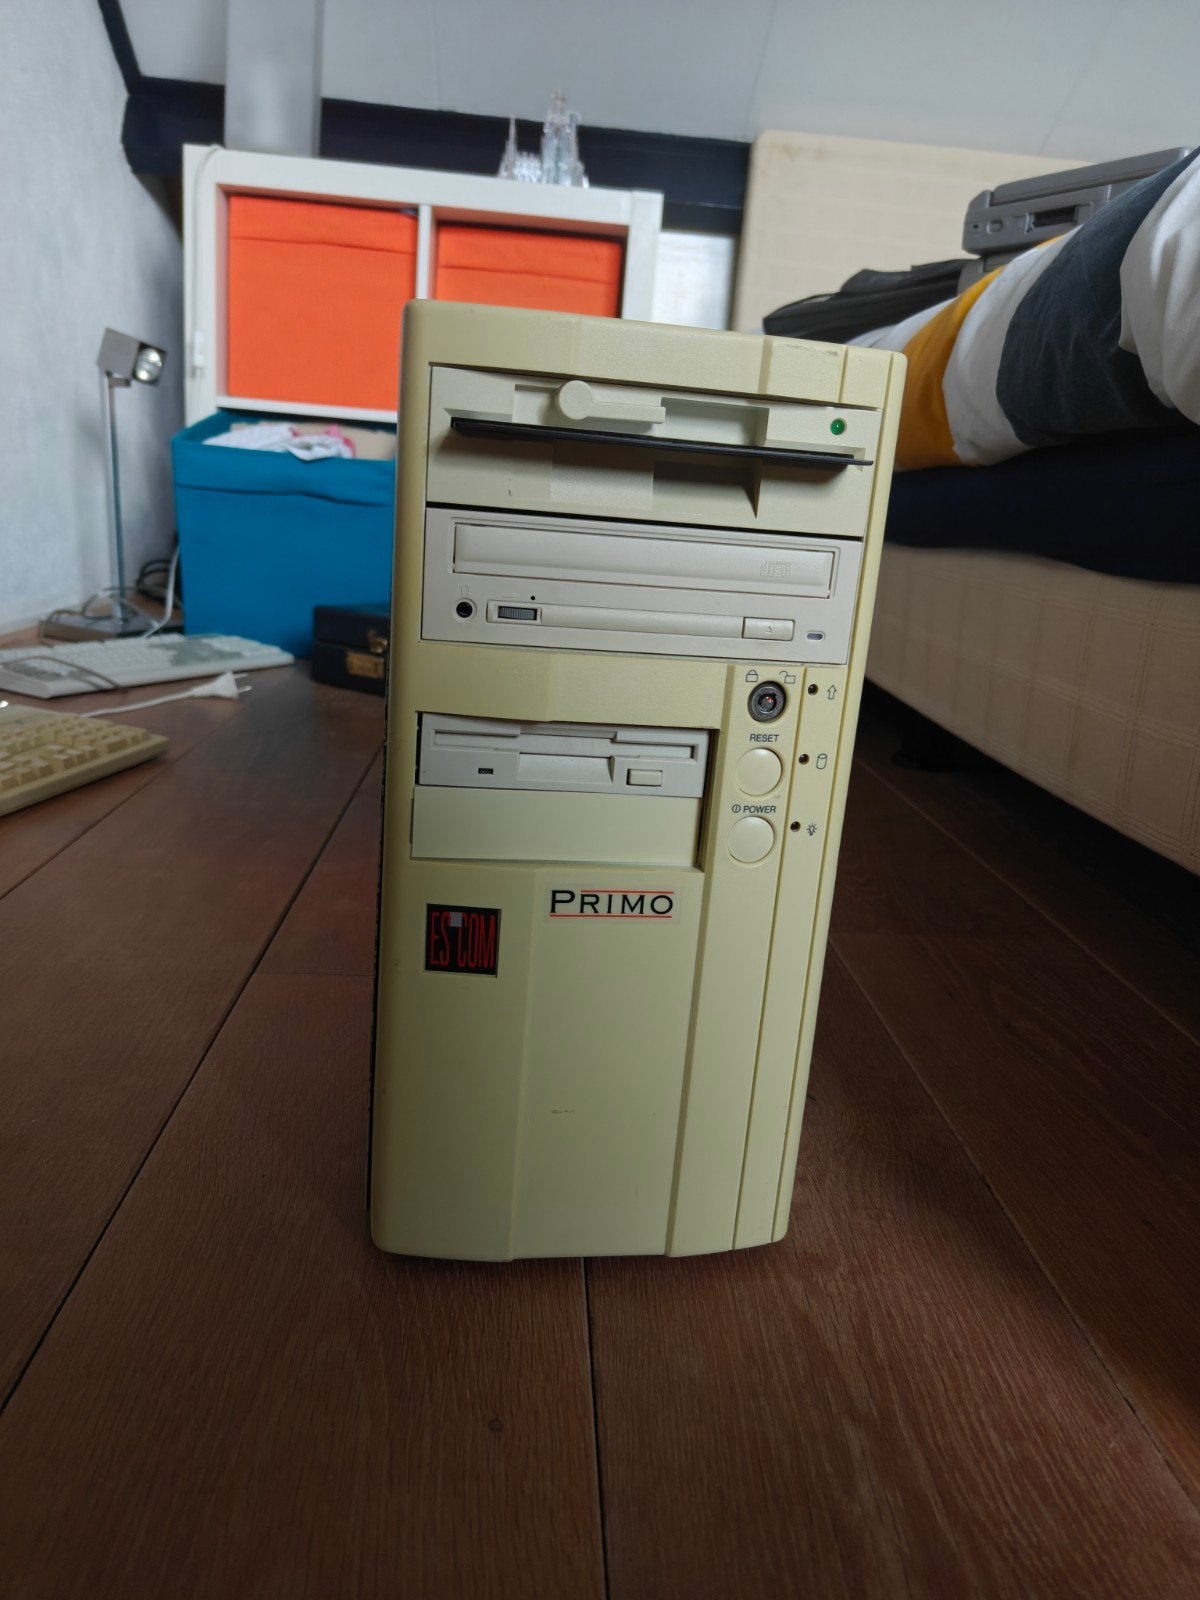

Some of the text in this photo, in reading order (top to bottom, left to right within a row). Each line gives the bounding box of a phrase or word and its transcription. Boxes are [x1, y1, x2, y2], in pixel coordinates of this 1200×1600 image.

[749, 733, 780, 742] RESET
[743, 805, 777, 814] POWER
[550, 890, 674, 915] PRIMO
